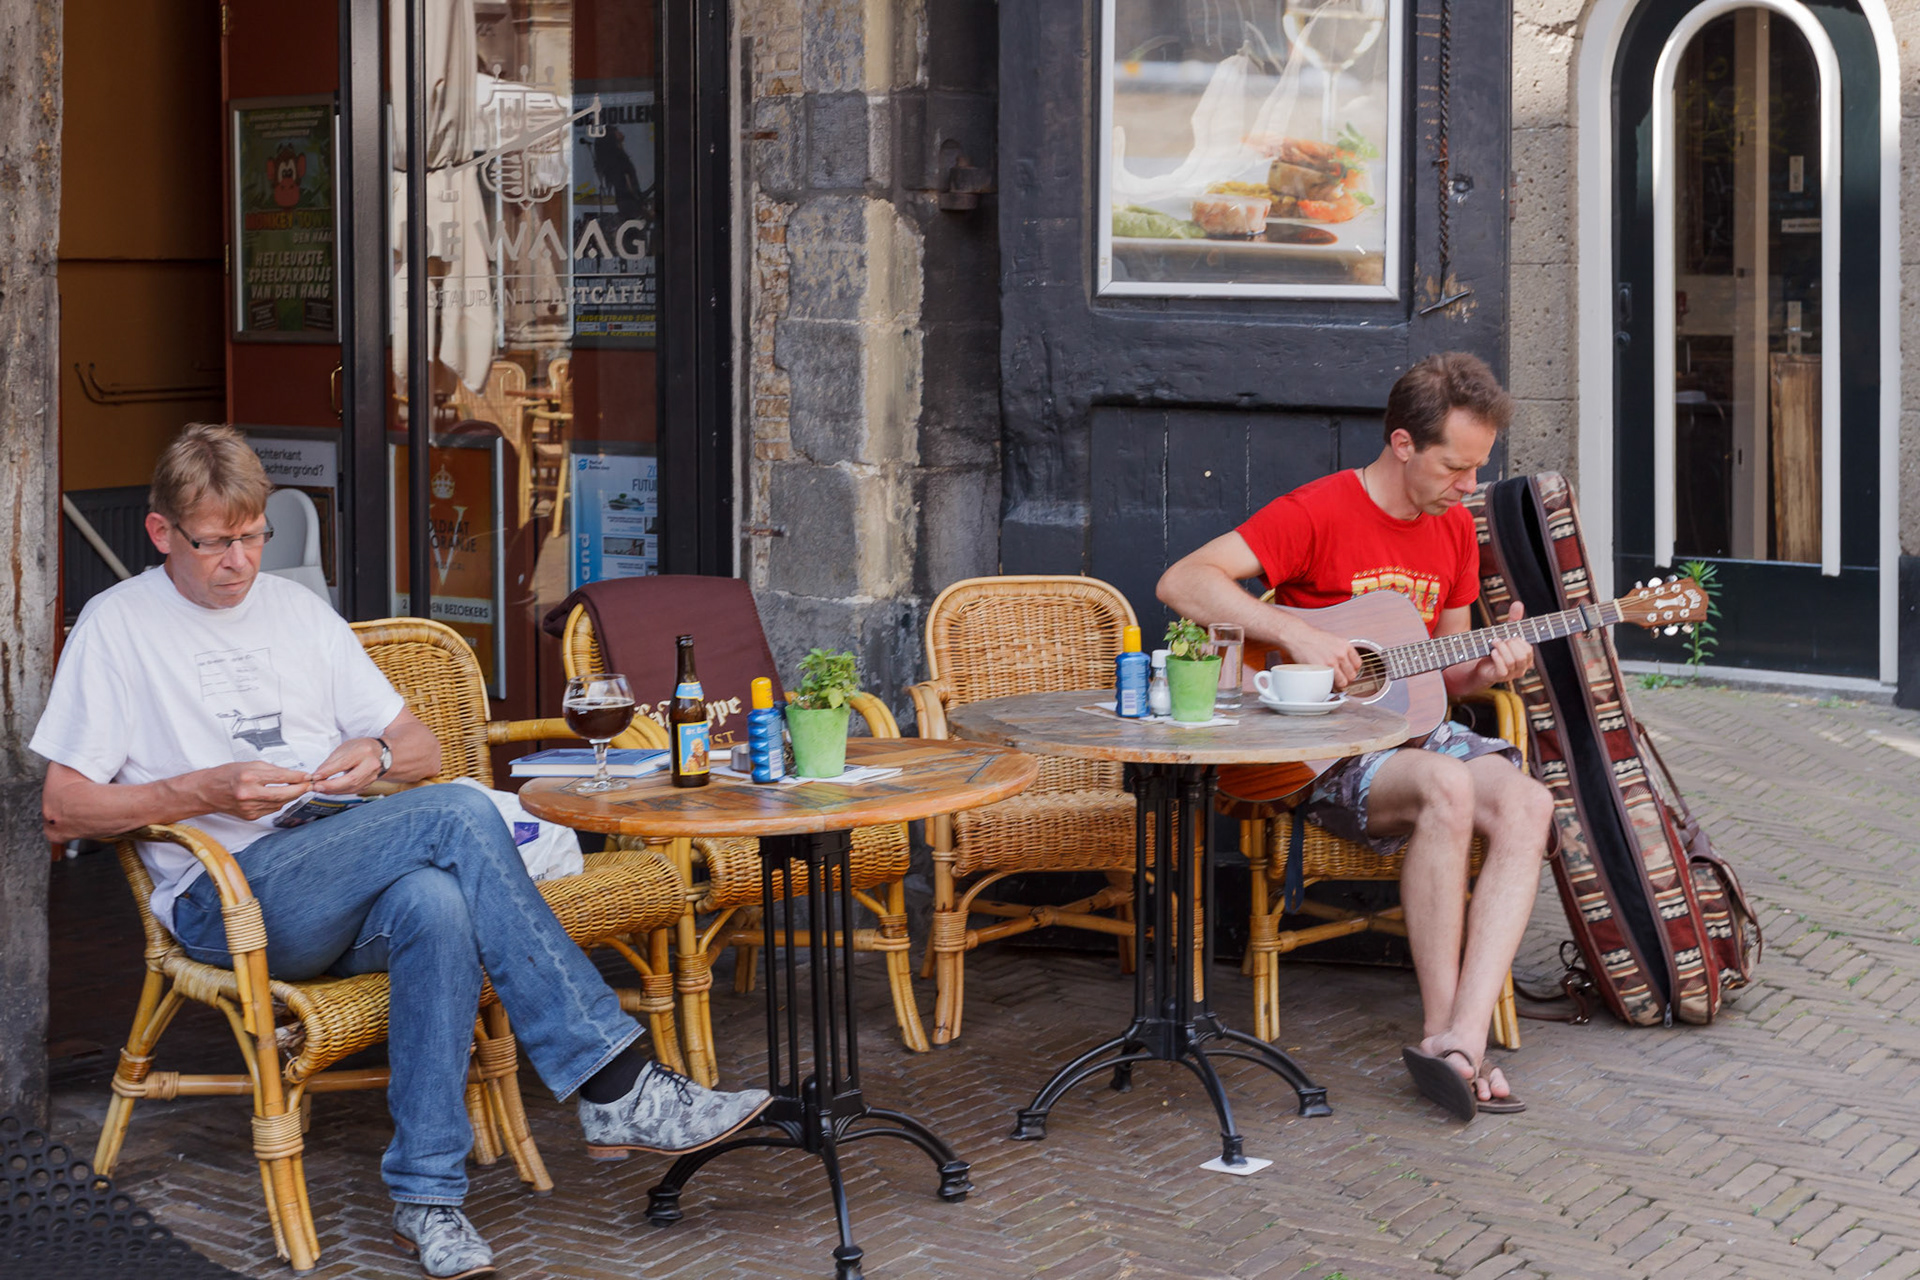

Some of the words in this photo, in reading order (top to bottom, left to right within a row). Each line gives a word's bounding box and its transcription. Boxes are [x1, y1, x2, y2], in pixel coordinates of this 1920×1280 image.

[245, 211, 294, 231] MONKEY
[474, 218, 646, 261] WAAG
[255, 251, 276, 267] HET
[279, 250, 325, 267] LEUKSTE
[248, 267, 332, 284] SPEELPARADIJS
[251, 284, 272, 299] VAN
[275, 284, 298, 300] DEN
[300, 284, 331, 300] HAAG
[632, 478, 658, 493] FUTU
[402, 599, 408, 611] 2
[444, 603, 489, 618] BEZOEKERS
